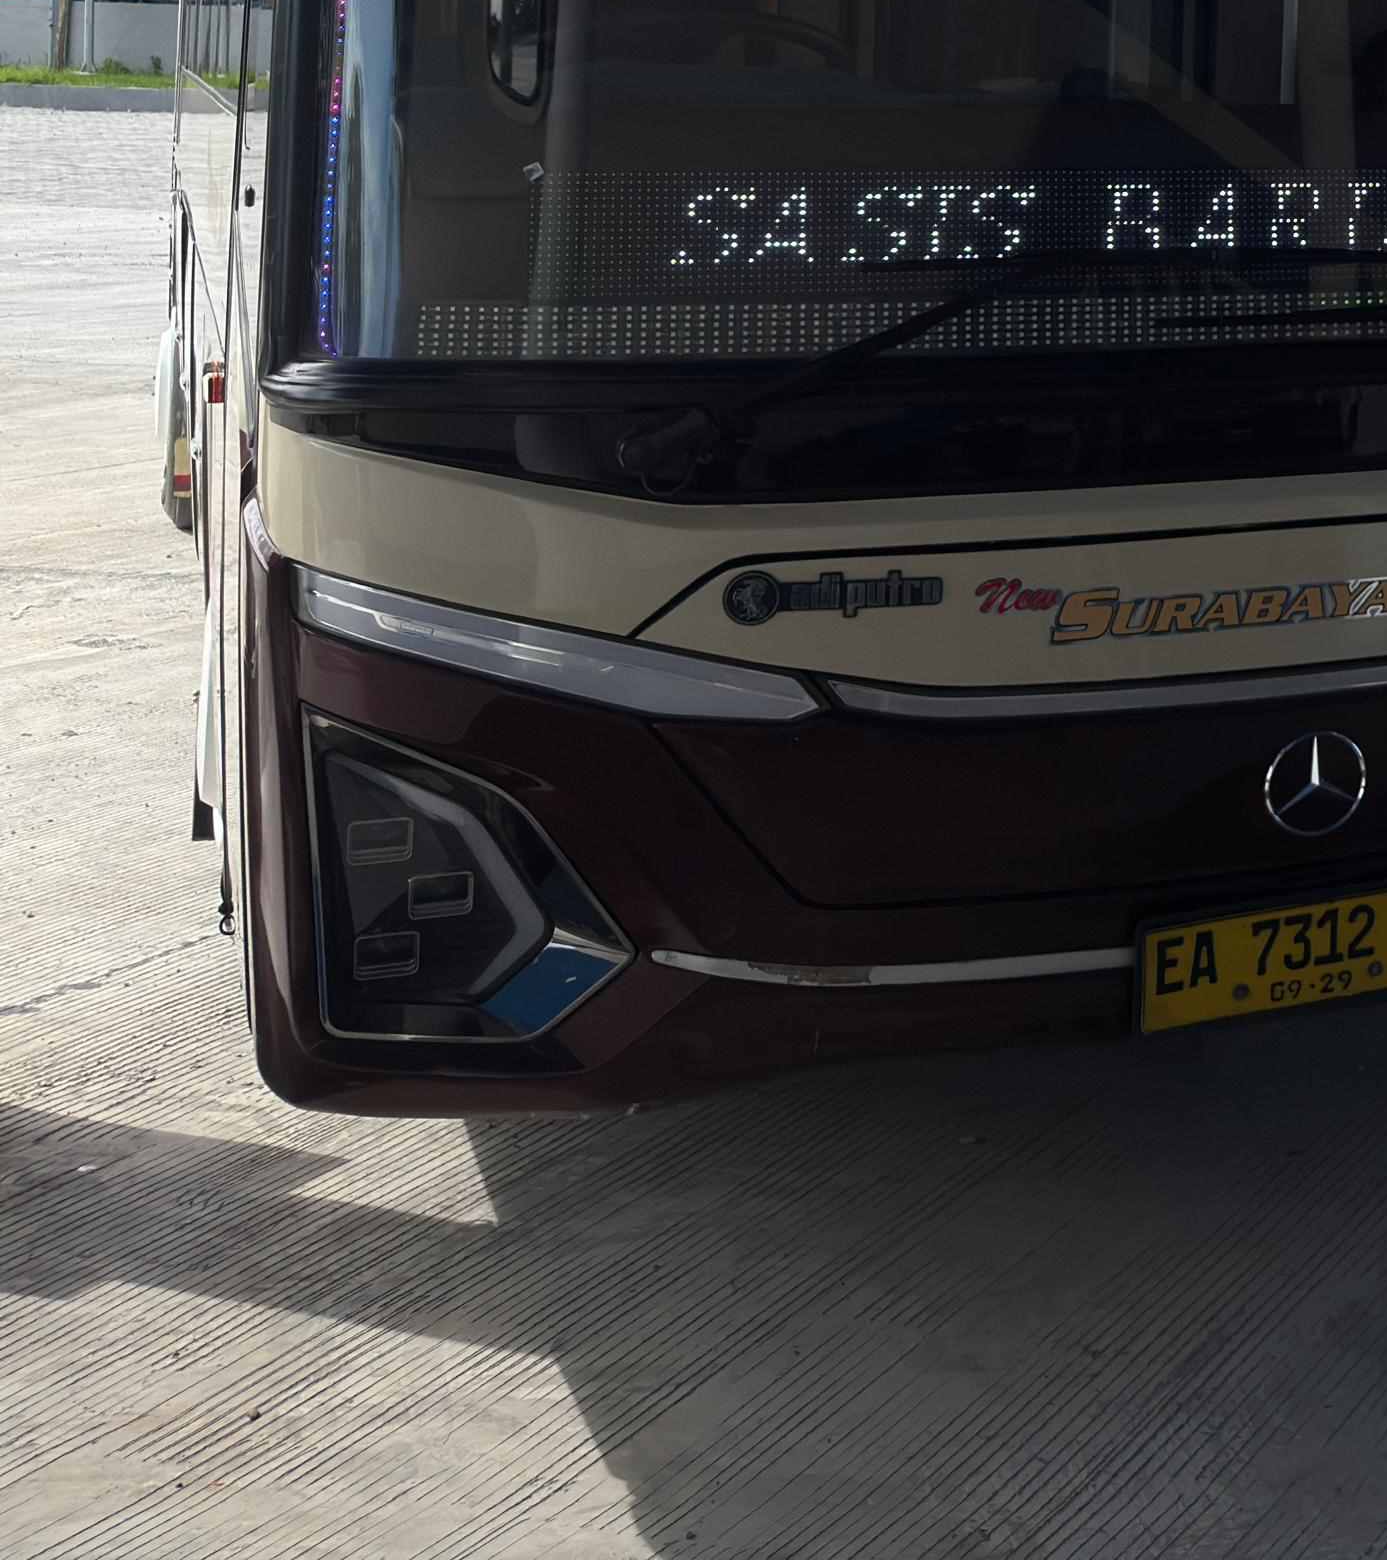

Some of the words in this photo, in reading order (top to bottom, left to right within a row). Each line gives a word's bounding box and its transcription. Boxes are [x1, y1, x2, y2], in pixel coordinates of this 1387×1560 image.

[975, 577, 1061, 615] New
[1155, 930, 1218, 996] EA
[1251, 904, 1377, 976] 7312
